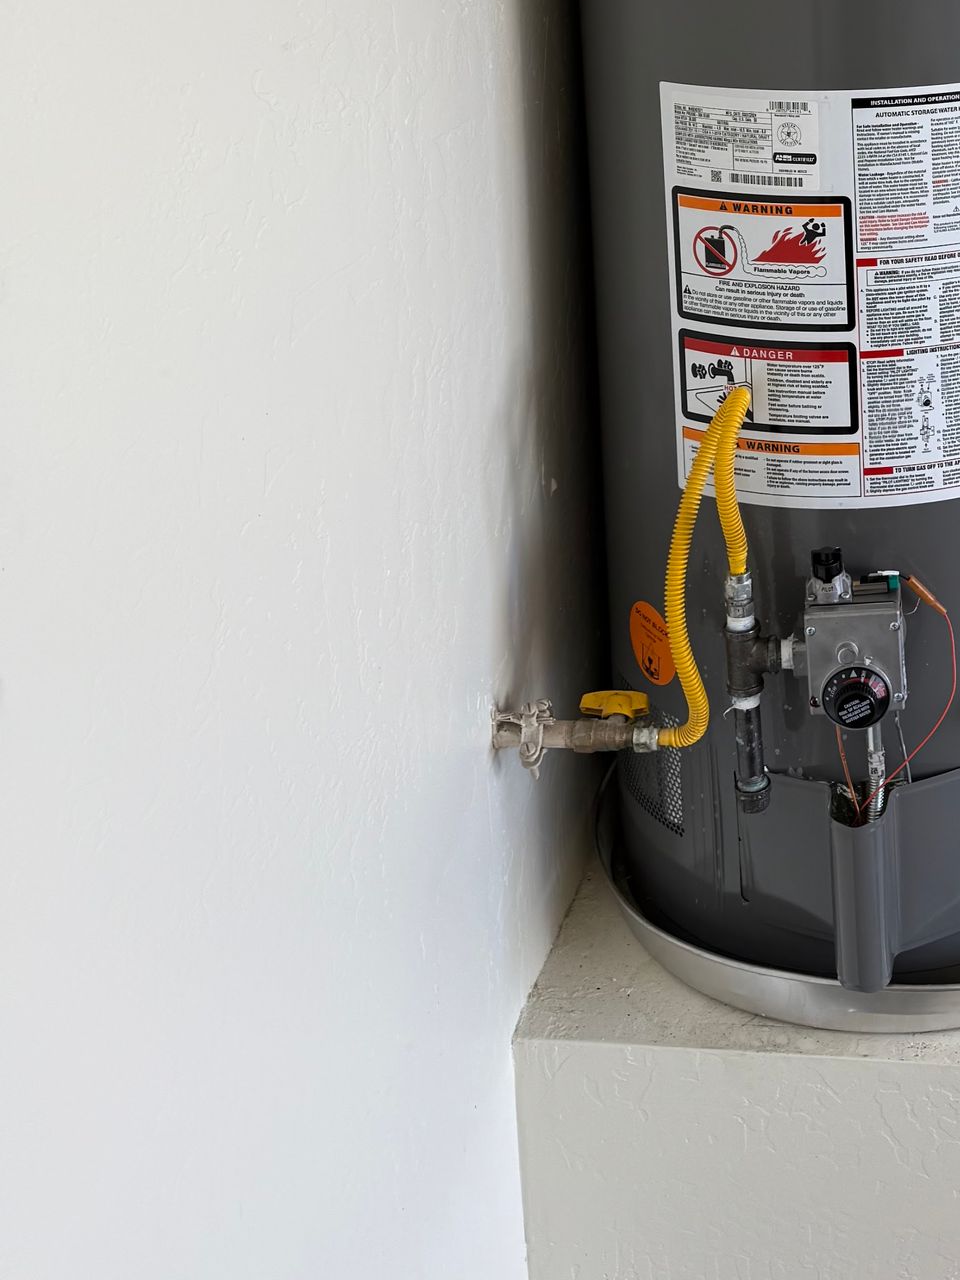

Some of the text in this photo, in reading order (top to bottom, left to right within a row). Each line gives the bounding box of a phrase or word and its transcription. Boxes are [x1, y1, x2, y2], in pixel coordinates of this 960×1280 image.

[870, 97, 913, 106] INSTALLATION
[928, 94, 959, 102] OPERATION
[875, 110, 910, 118] AUTOMATIC
[911, 108, 937, 116] STORAGE
[936, 105, 958, 113] WATER
[732, 202, 793, 215] WARNING
[905, 256, 924, 264] SAFETY
[938, 252, 957, 261] BEFORE
[754, 266, 787, 274] Flammable
[718, 279, 731, 287] FIRE
[743, 348, 793, 360] DANGER
[746, 440, 800, 453] WARNING
